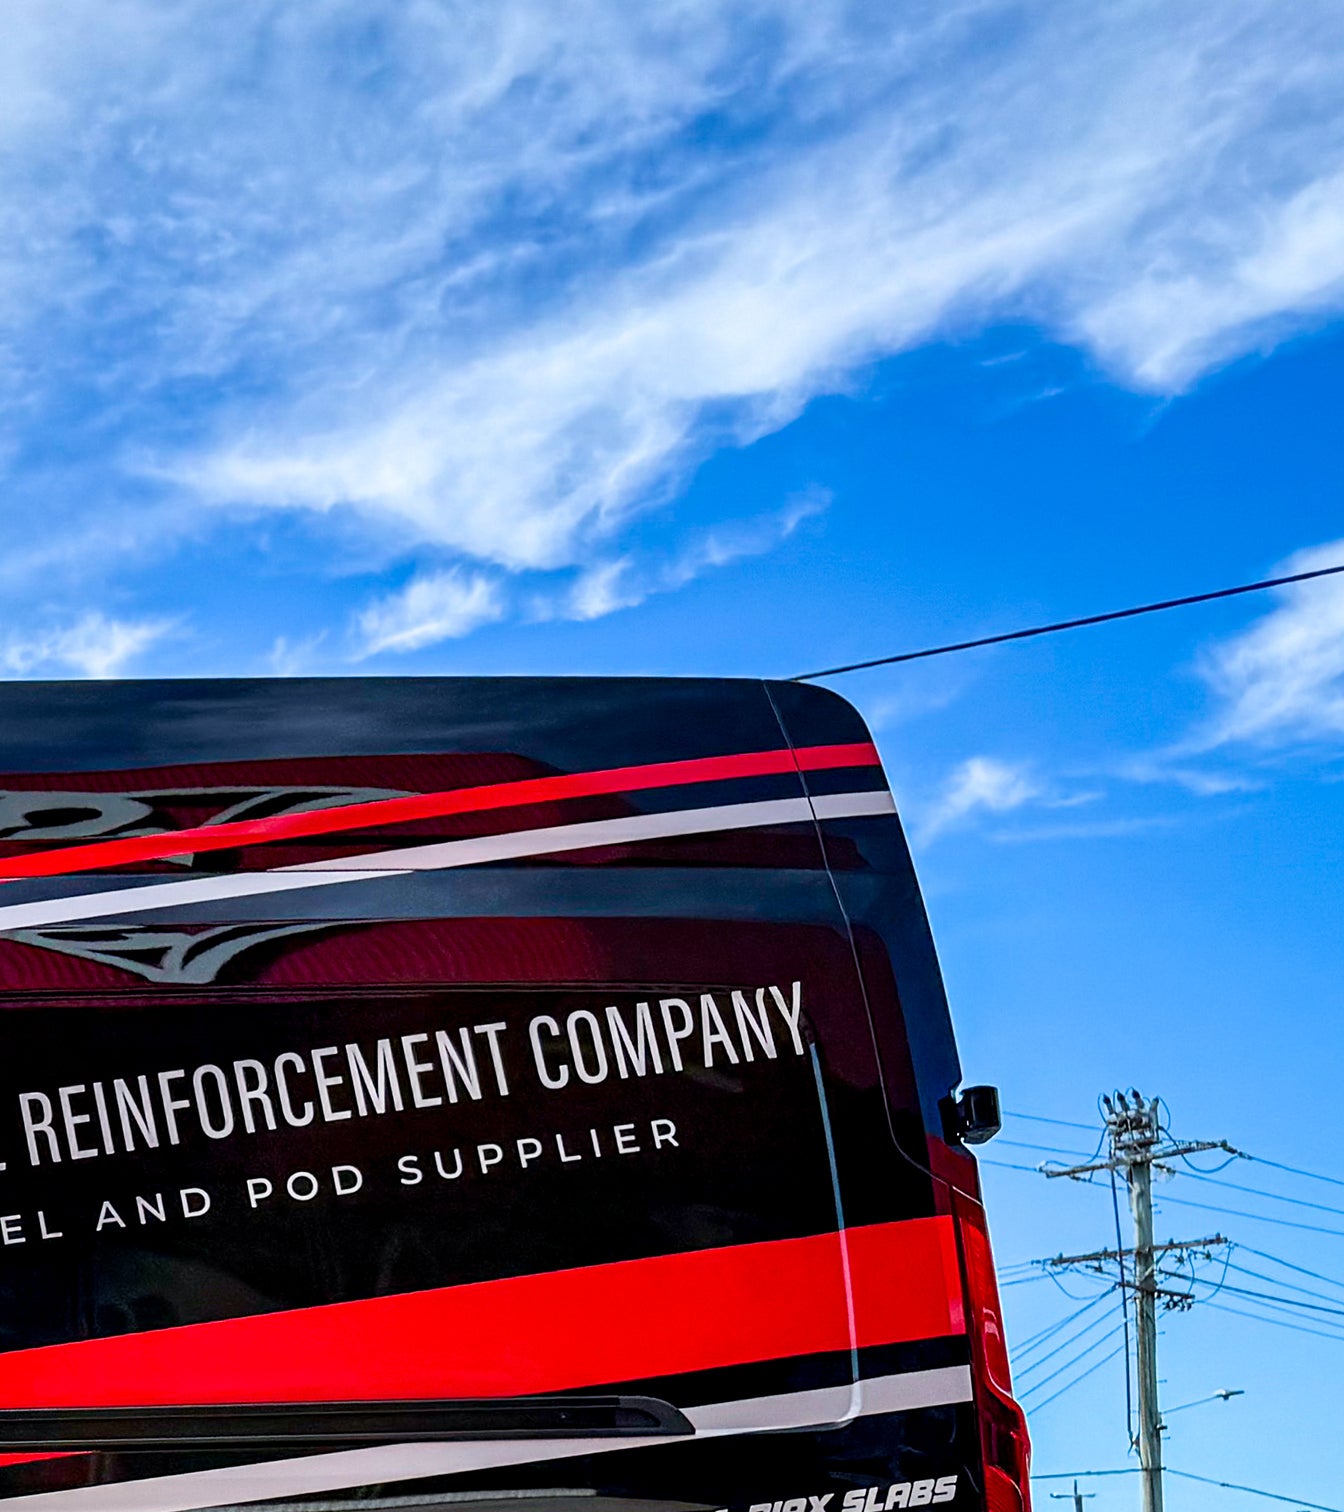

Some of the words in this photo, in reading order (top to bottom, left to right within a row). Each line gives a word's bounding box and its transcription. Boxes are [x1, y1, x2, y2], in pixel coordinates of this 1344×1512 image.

[19, 1021, 510, 1167] REINFORCEMENT
[528, 981, 805, 1090] COMPANY
[95, 1187, 212, 1232] AND
[246, 1164, 364, 1209] POD
[398, 1118, 680, 1186] SUPPLIER
